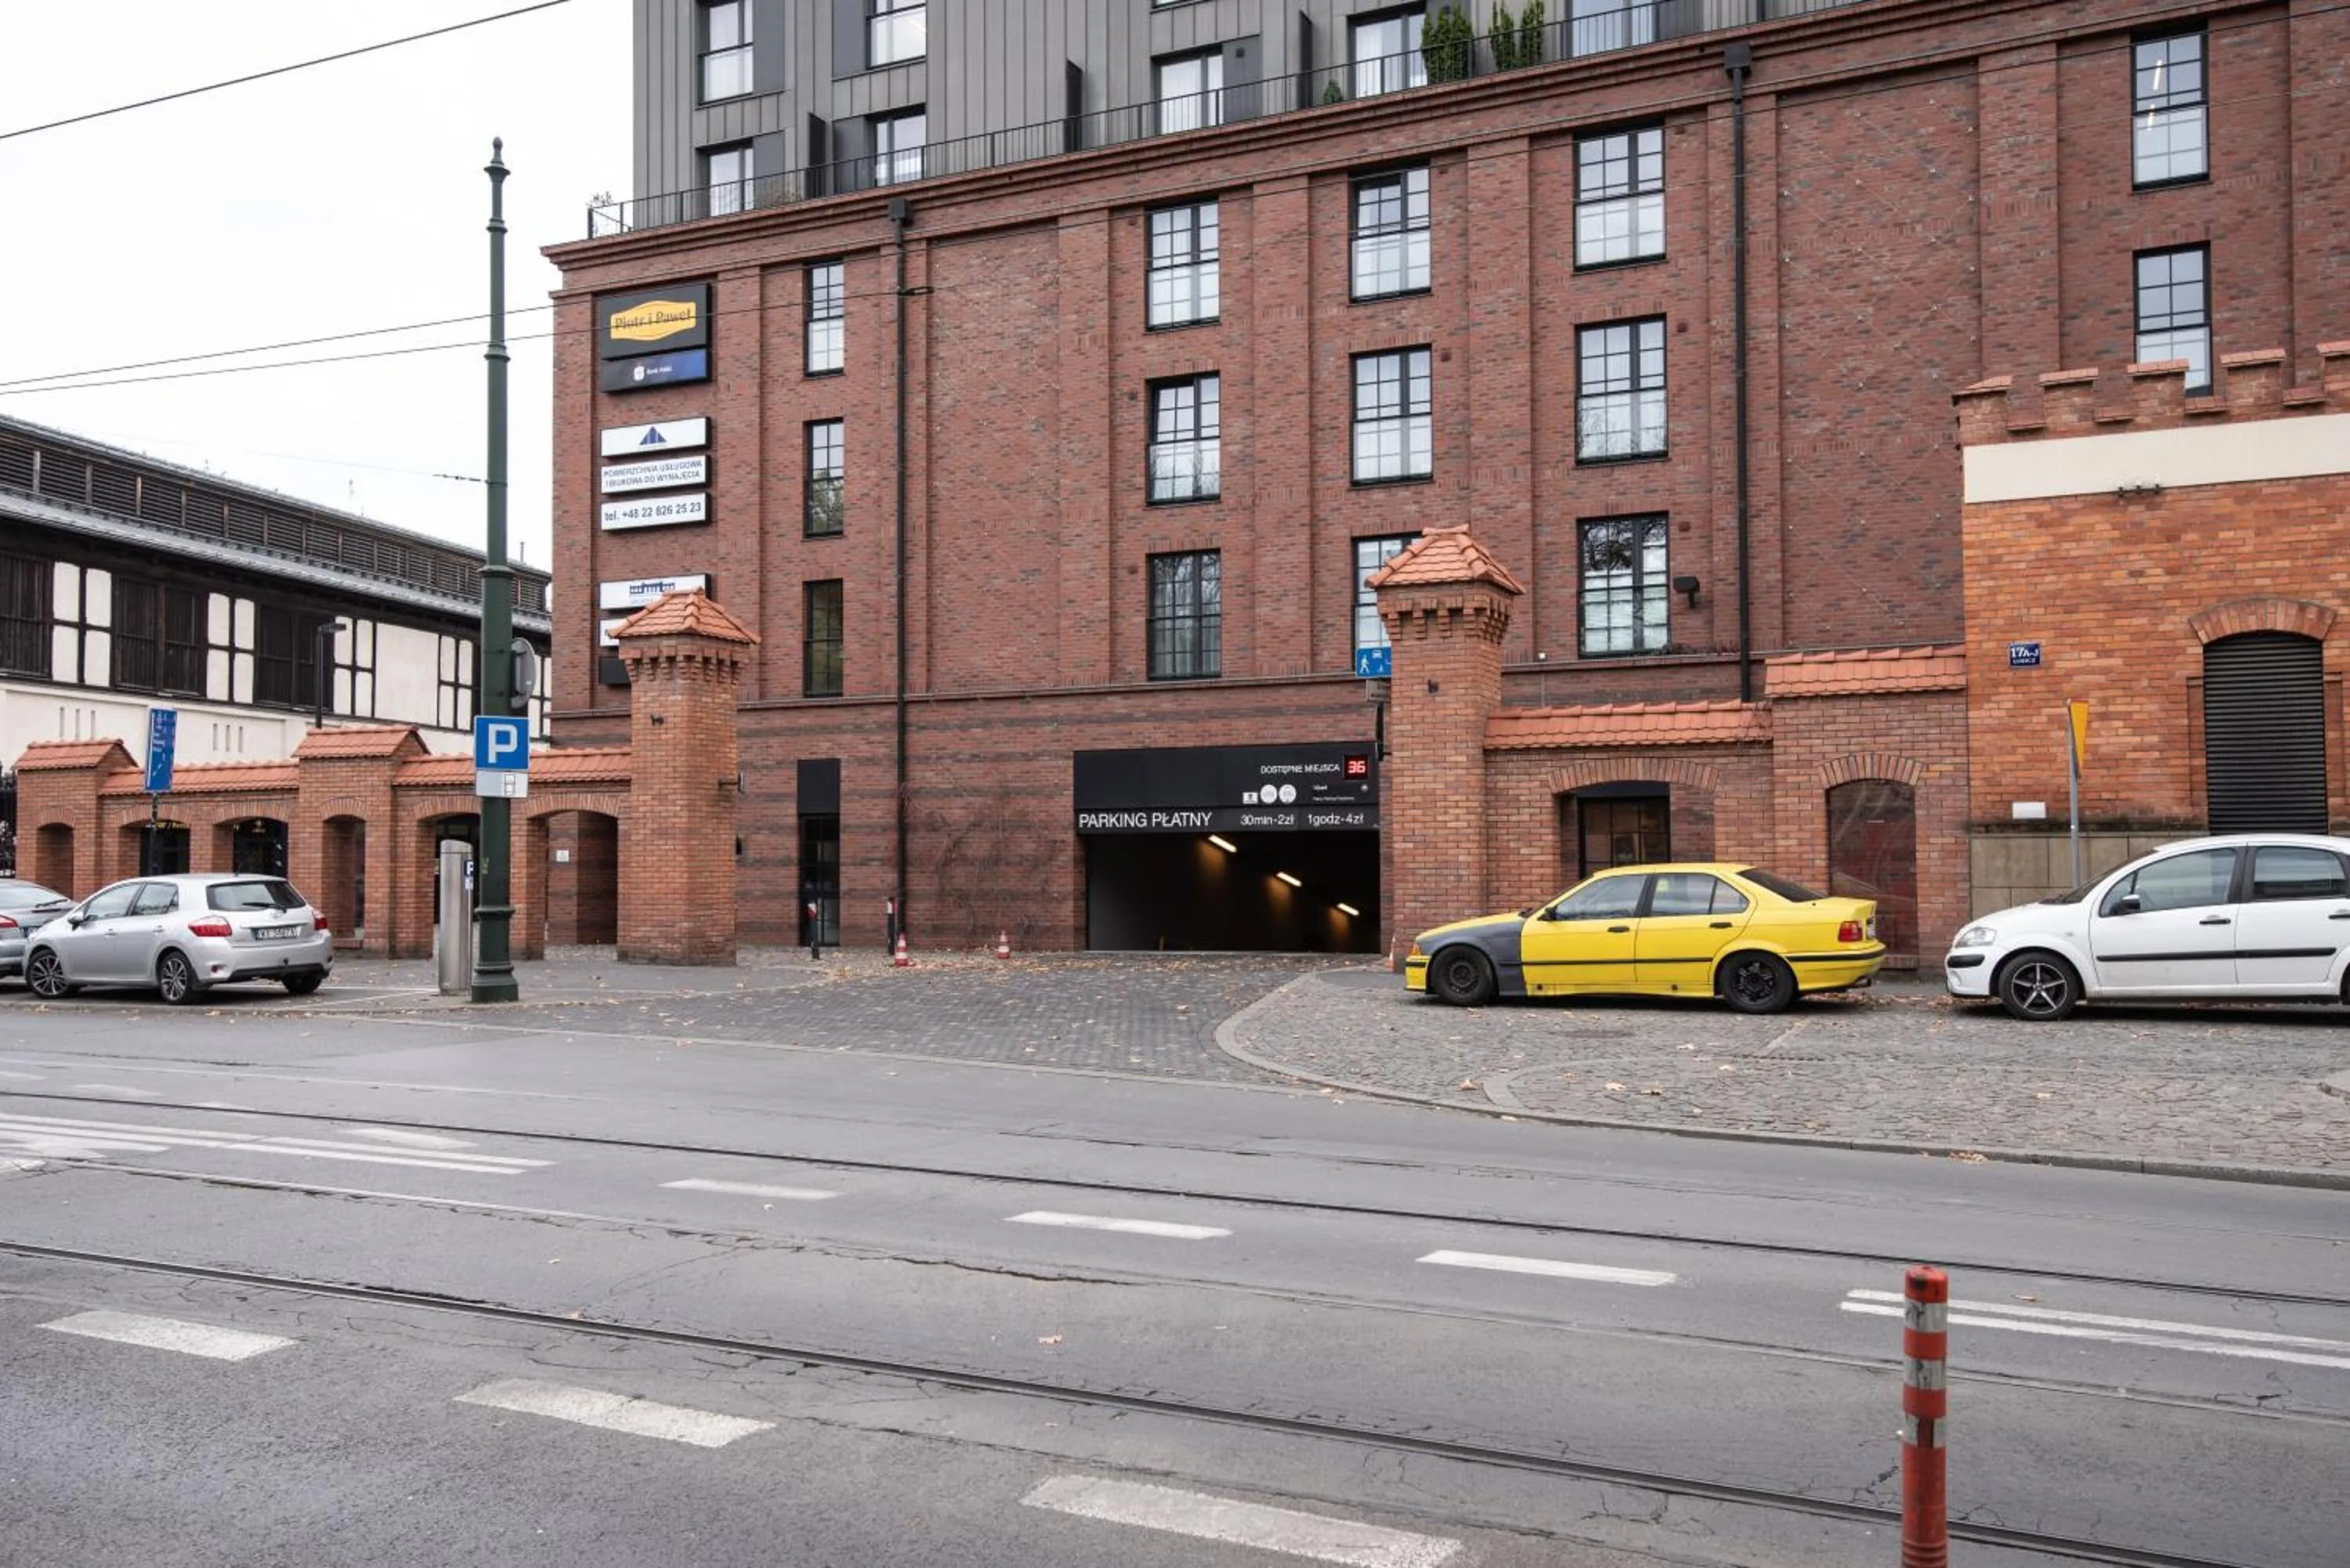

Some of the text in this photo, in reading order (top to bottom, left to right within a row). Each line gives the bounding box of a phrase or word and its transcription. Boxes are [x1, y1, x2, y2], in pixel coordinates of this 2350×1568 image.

[605, 511, 620, 521] tel.
[622, 508, 639, 518] +48
[642, 507, 653, 517] 22
[676, 504, 687, 515] 25
[690, 501, 701, 512] 23
[488, 723, 518, 764] P
[1260, 764, 1340, 775] DOSTĘPNE MIEJSCA
[1348, 761, 1366, 774] 36
[1079, 811, 1212, 828] PARKING PŁATNY
